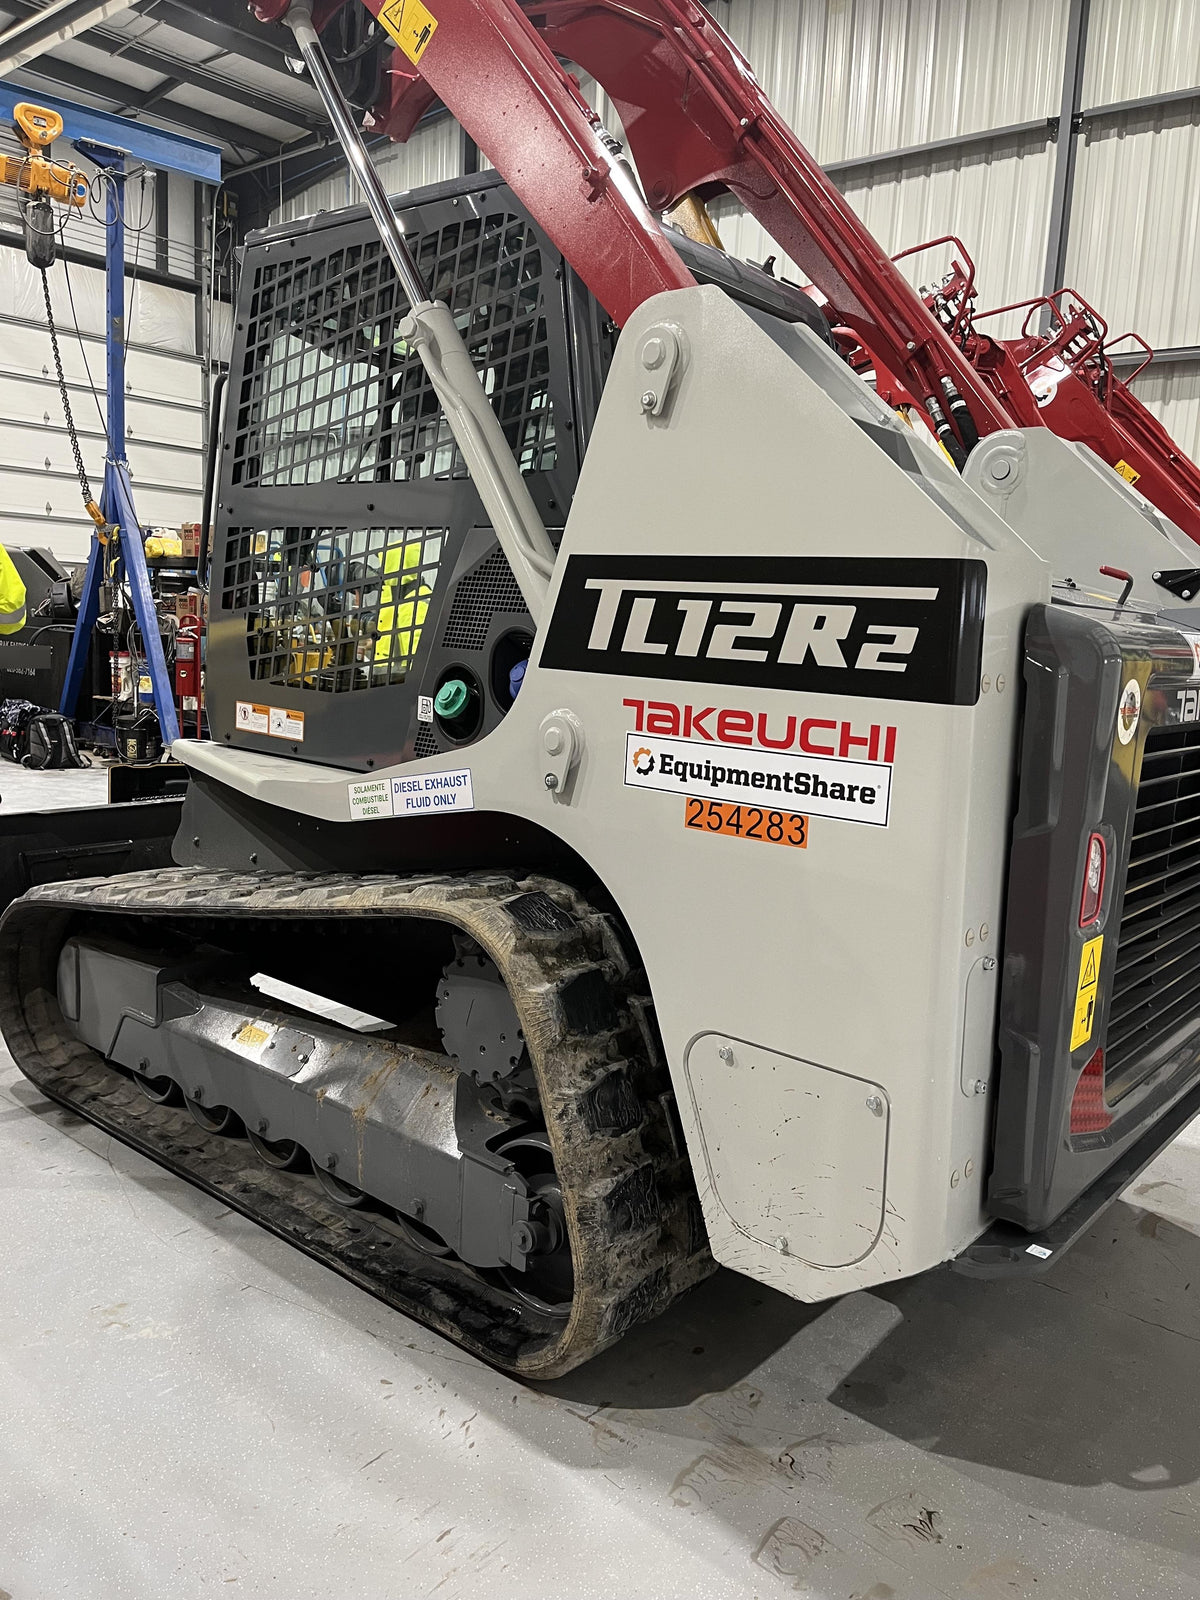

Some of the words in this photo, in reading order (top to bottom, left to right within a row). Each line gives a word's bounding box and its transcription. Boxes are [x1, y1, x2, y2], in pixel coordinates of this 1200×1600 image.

[585, 578, 939, 672] TL12R2
[353, 783, 385, 794] SOLAMENTE
[394, 780, 423, 794] DIESEL
[424, 775, 468, 790] EXHAUST
[658, 752, 876, 806] EquipmentShare
[352, 794, 389, 805] COMBUSTIBLE
[405, 796, 432, 809] FLUID
[433, 793, 457, 807] ONLY
[686, 798, 807, 846] 254283
